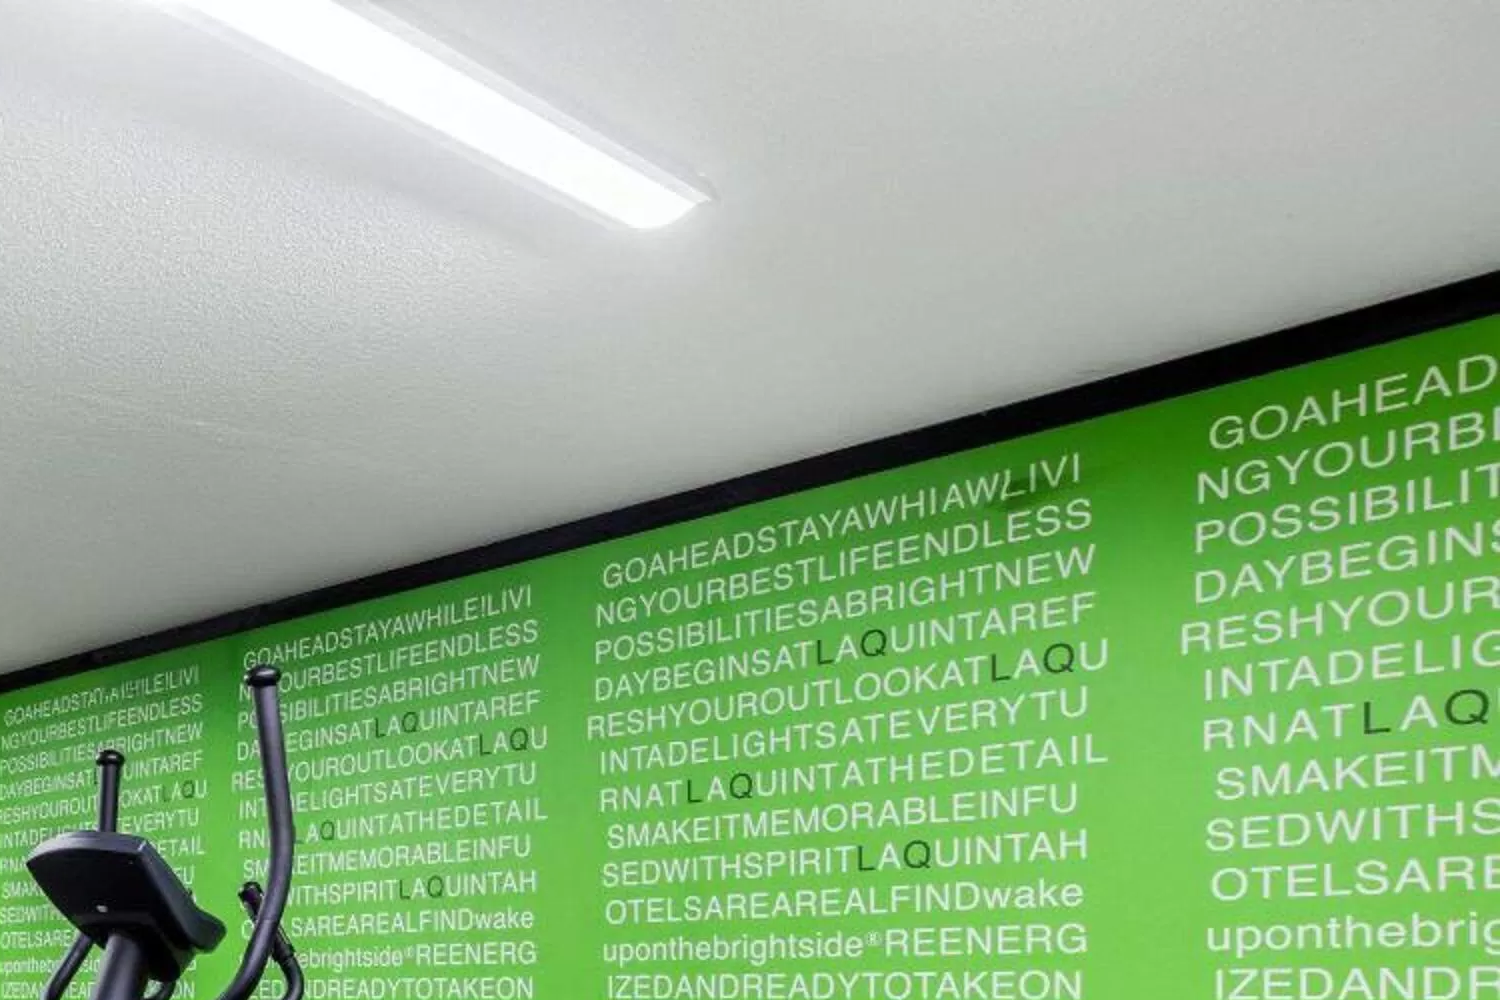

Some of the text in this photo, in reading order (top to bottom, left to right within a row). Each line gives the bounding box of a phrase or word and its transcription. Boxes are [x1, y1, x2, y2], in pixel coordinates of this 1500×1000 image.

[1197, 405, 1498, 503] NGYOURB
[596, 495, 1091, 627] NGYOURBESTLIFEENDLESS
[1195, 517, 1498, 602] DAYBEGIN
[595, 542, 1094, 665] POSSIBILITIESABRIGHTNEW
[595, 589, 1094, 701] DAYBEGINSATLAQUINTAREF
[587, 635, 1109, 740] RESHYOUROUTLOOKATLAQU
[1203, 686, 1498, 750] RNATLAQ
[600, 731, 1108, 812] RNATLAQUINTATHEDETAIL
[601, 686, 1086, 775] INTADELIGHTSATEVERYTU
[603, 828, 1086, 886] SEDWITHSPIRITLAQUINTAH
[607, 782, 1076, 849] SMAKEITMEMORABLEINFU
[605, 875, 1082, 924] OTELSAREAREALFINDwake
[608, 970, 1081, 999] IZEDANDREADYTOTAKEON
